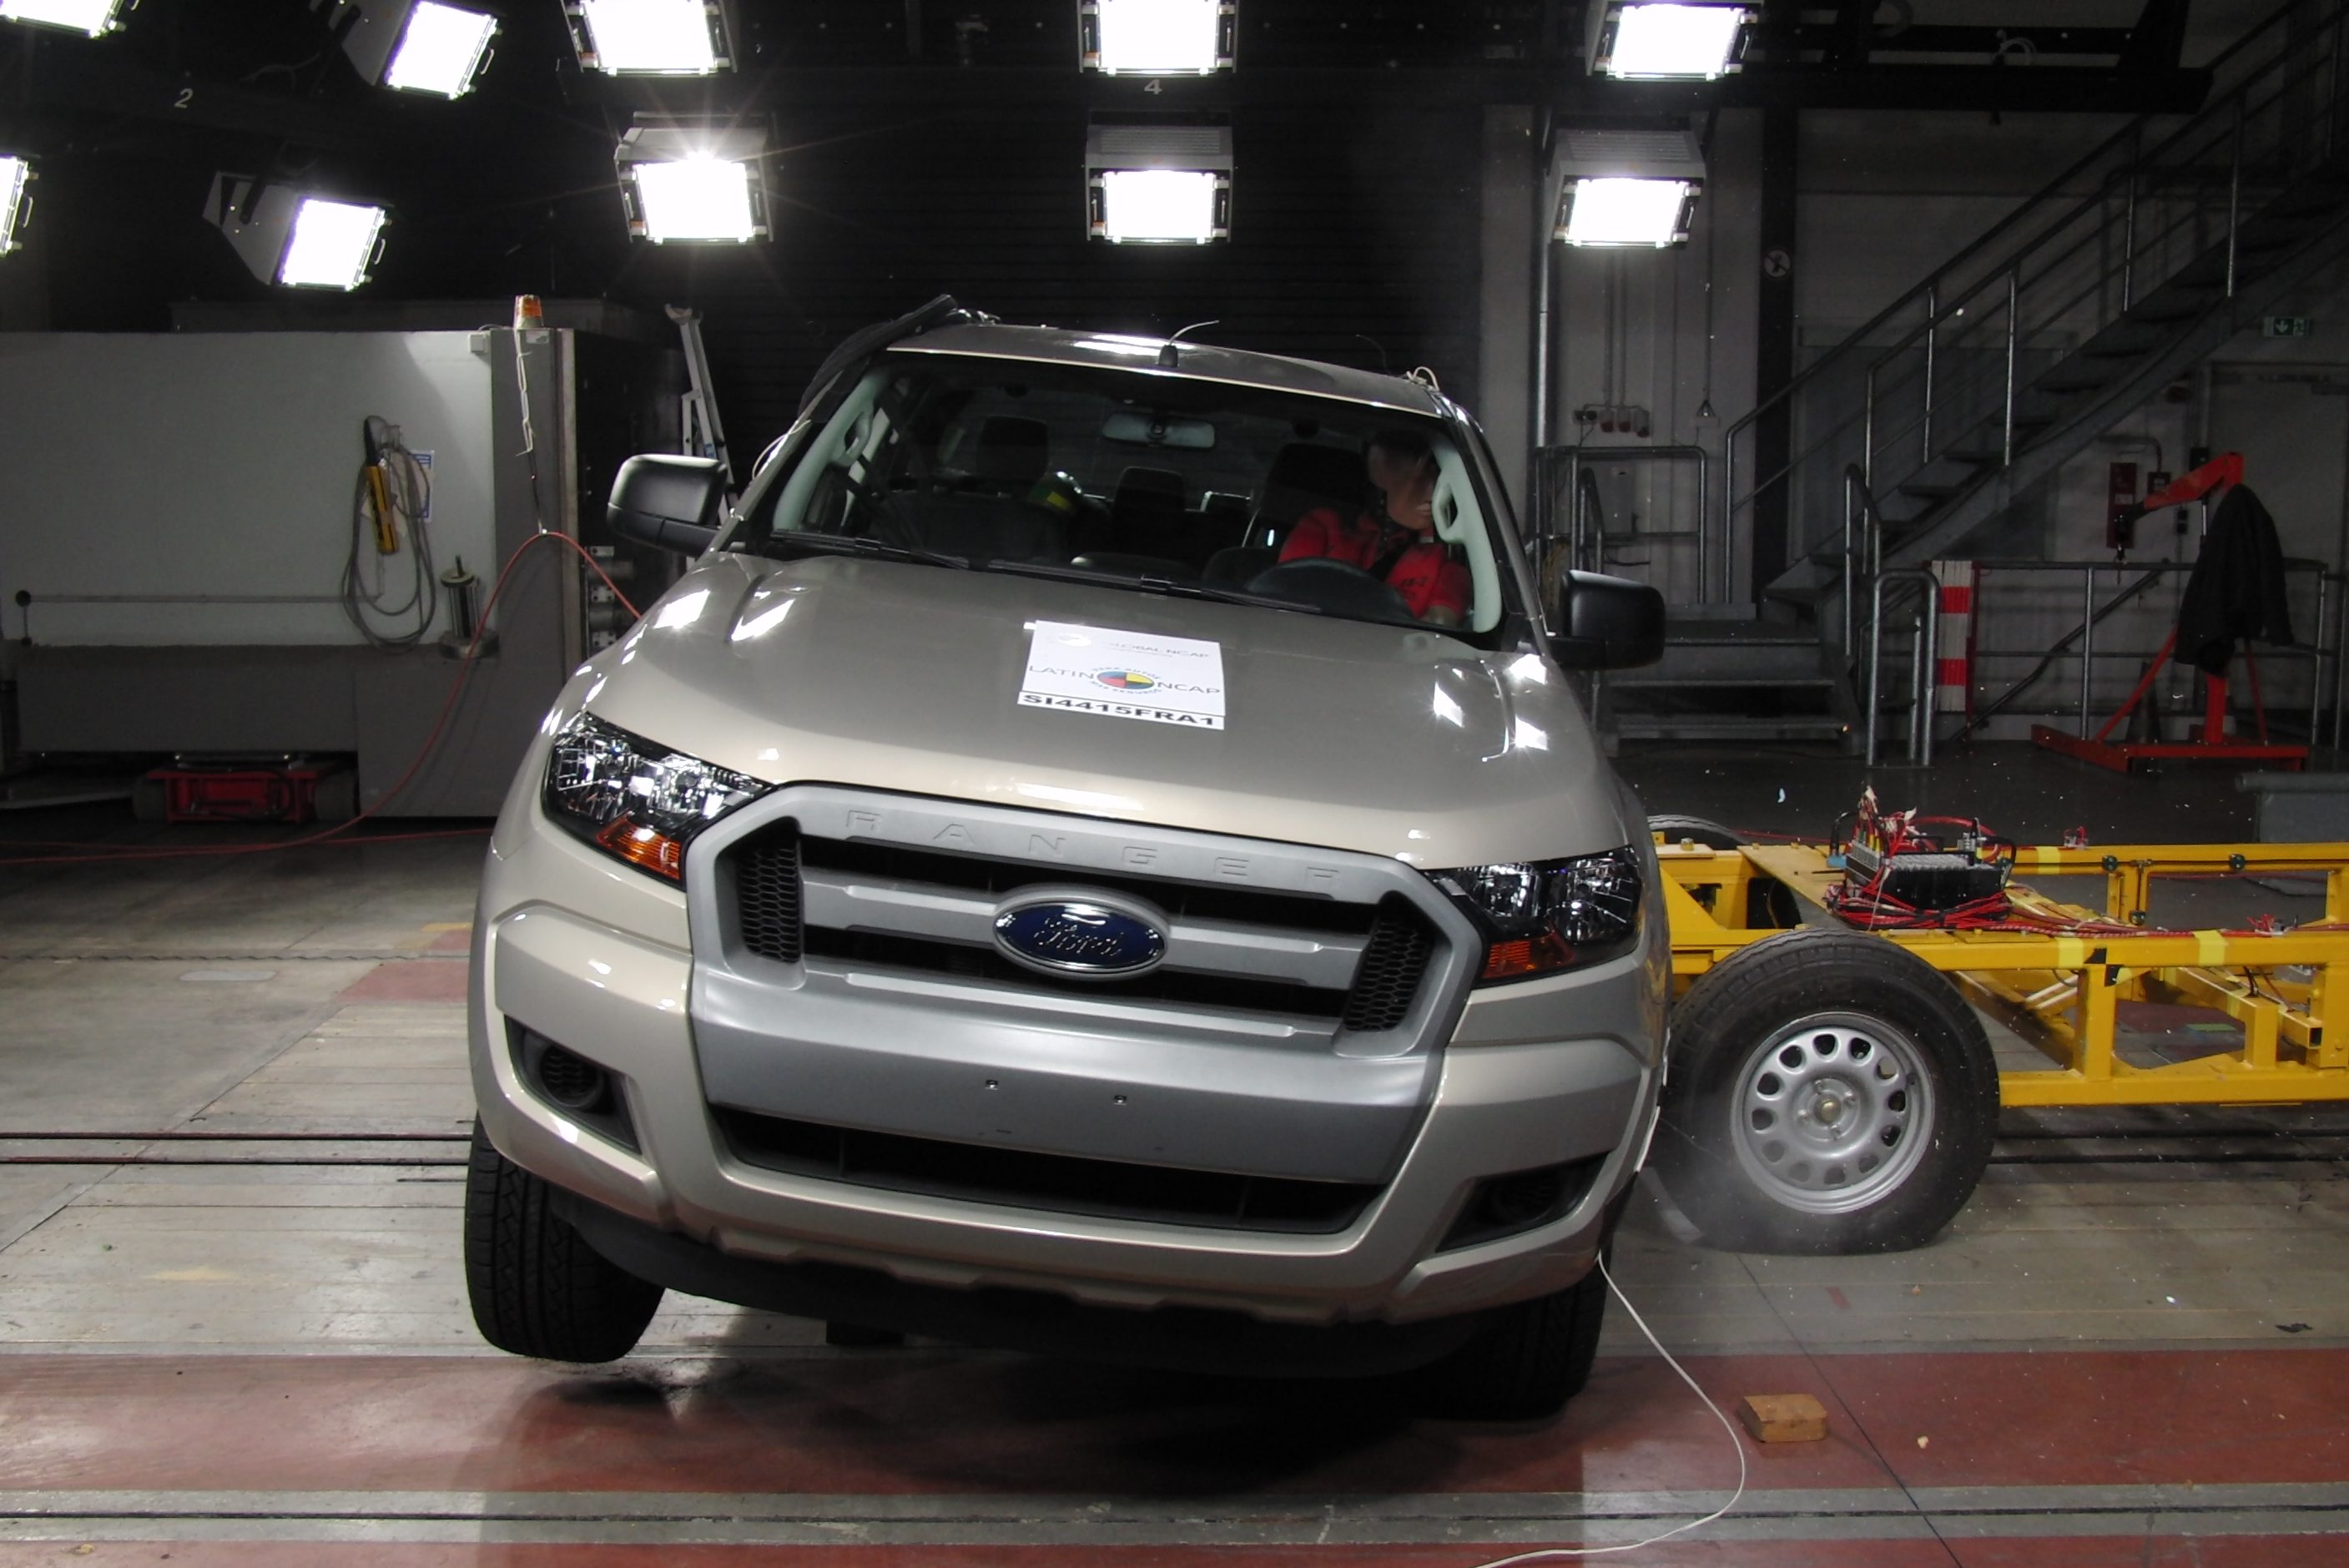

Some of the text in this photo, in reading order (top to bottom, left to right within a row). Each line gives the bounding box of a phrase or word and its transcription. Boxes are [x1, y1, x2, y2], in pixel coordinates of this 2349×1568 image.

[174, 88, 193, 108] 2
[1144, 79, 1162, 94] 4
[1030, 665, 1094, 680] LATIN
[1157, 681, 1220, 694] NCAP
[1024, 694, 1214, 725] SI4415FRA1
[845, 809, 1340, 885] RANGER
[1034, 917, 1123, 956] Ford
